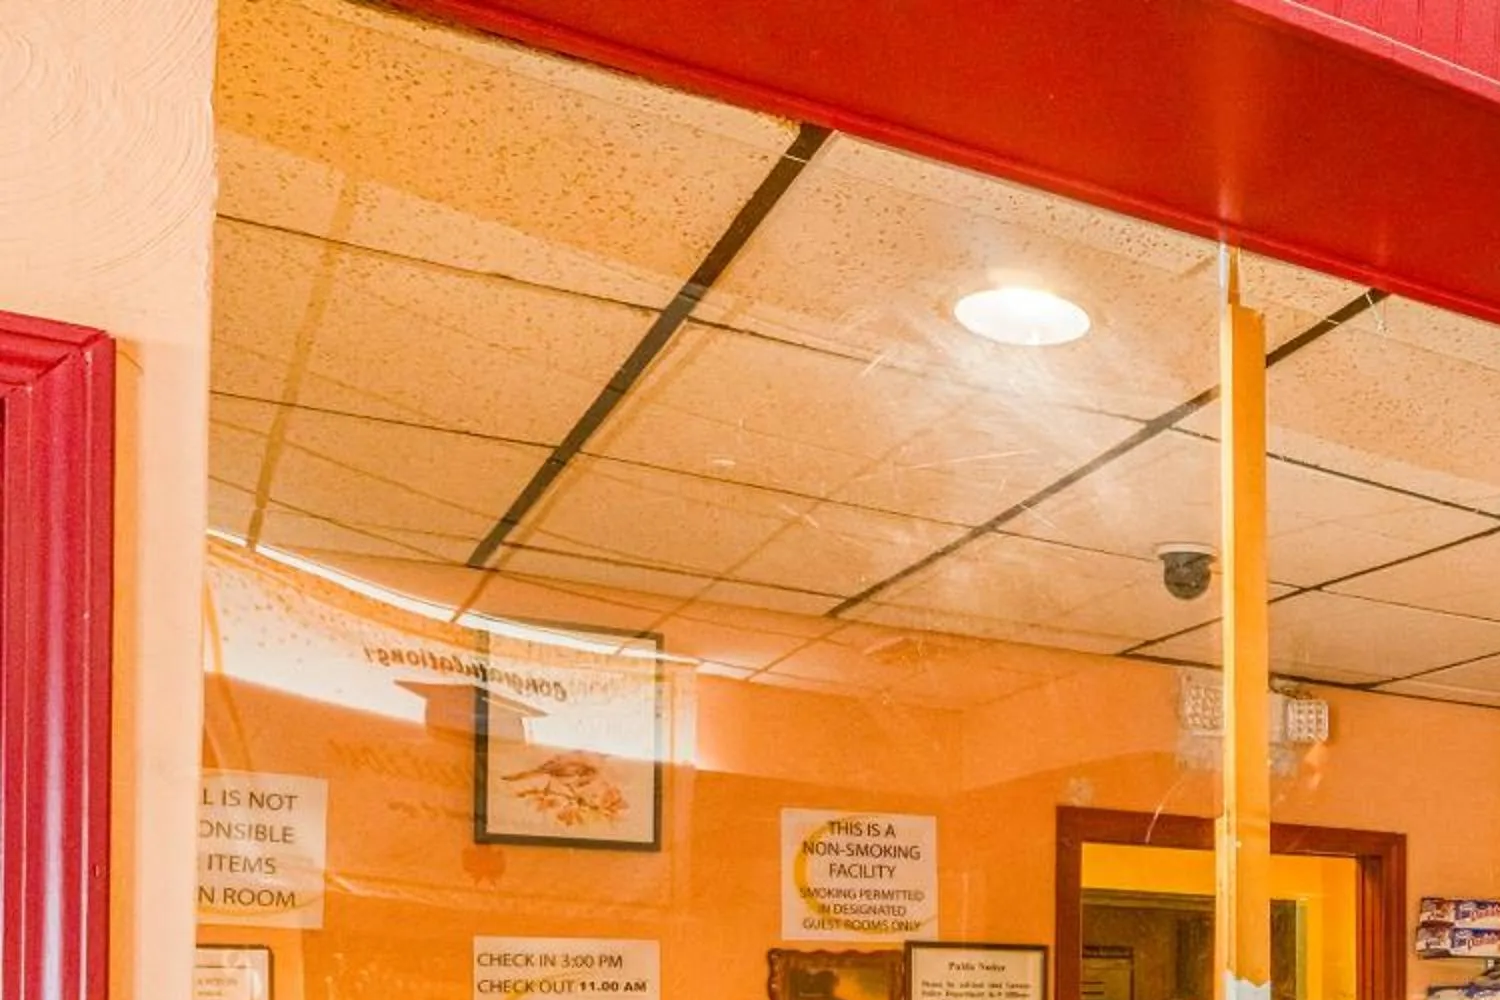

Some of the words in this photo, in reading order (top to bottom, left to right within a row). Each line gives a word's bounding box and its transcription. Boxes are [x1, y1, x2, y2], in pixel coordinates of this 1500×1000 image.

[221, 789, 241, 807] IS
[248, 791, 299, 811] NOT
[199, 820, 295, 844] ONSIBLE
[827, 820, 863, 837] THIS
[867, 823, 881, 837] IS
[885, 824, 897, 838] A
[802, 841, 921, 860] NON-SMOKING
[207, 853, 277, 875] ITEMS
[829, 862, 896, 879] FACILITY
[197, 885, 215, 905] N
[222, 887, 297, 908] ROOM
[800, 887, 857, 899] SMOKING
[859, 888, 925, 901] PERMITTED
[833, 903, 906, 917] DESIGNATED
[802, 918, 841, 930] GUEST
[843, 919, 888, 931] ROOMS
[891, 919, 921, 932] ONLY
[477, 953, 535, 969] CHECK
[539, 954, 556, 968] IN
[562, 955, 595, 969] 3:00
[599, 954, 623, 969] PM
[477, 979, 535, 994] CHECK
[539, 979, 575, 993] OUT
[624, 981, 647, 992] AM
